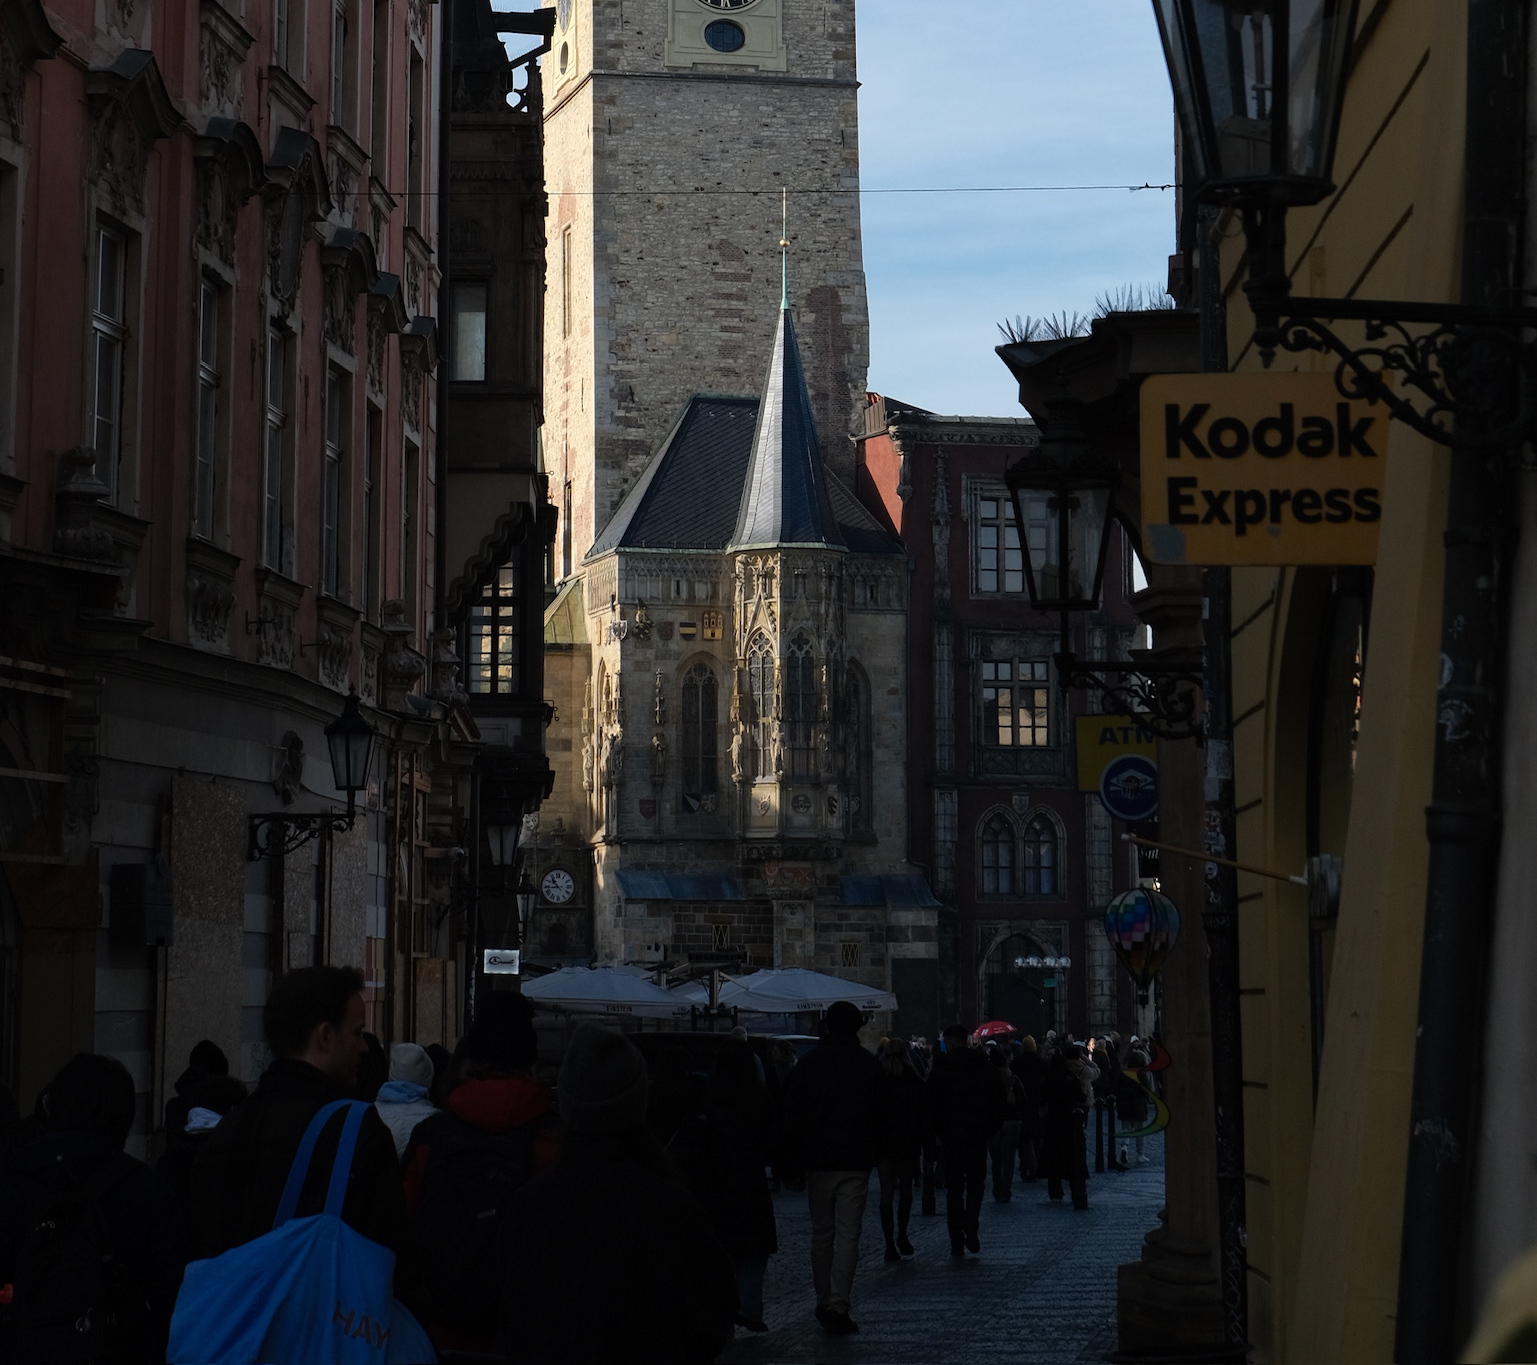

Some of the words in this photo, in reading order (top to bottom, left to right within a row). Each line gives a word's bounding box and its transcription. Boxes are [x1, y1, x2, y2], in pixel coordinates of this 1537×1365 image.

[1164, 402, 1377, 459] Kodak
[1166, 476, 1382, 537] Express
[333, 1299, 392, 1349] HAY
